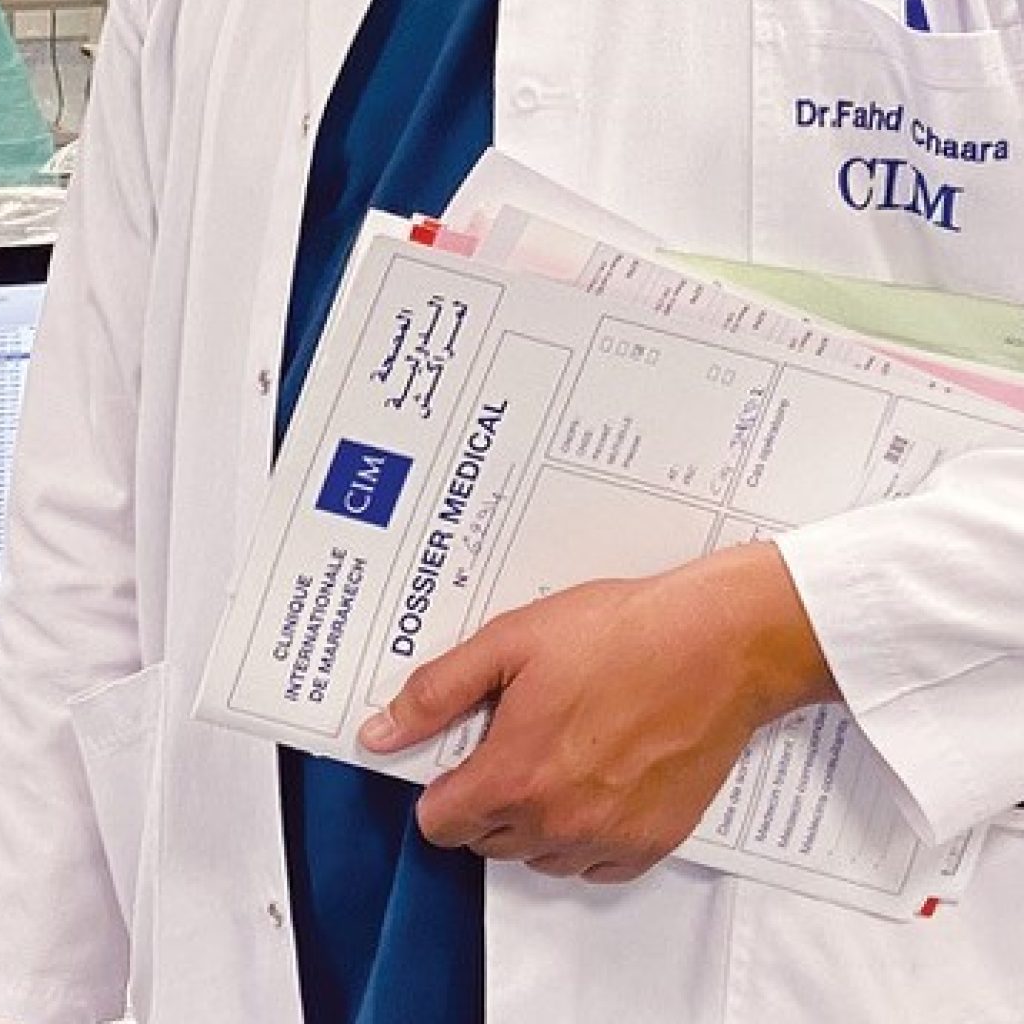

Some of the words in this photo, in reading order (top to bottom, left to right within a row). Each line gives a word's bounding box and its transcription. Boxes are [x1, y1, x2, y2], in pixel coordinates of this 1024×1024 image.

[794, 97, 905, 132] Dr.Fahd
[911, 118, 1009, 163] Chaara
[837, 157, 965, 233] CIM
[344, 456, 385, 514] CIM
[390, 529, 454, 657] DOSSIER
[438, 400, 508, 525] MEDICAL
[273, 574, 313, 662] CLINIQUE
[284, 546, 348, 702] INTERNATIONALE
[317, 557, 368, 674] MARRAKECH
[308, 677, 330, 703] DE
